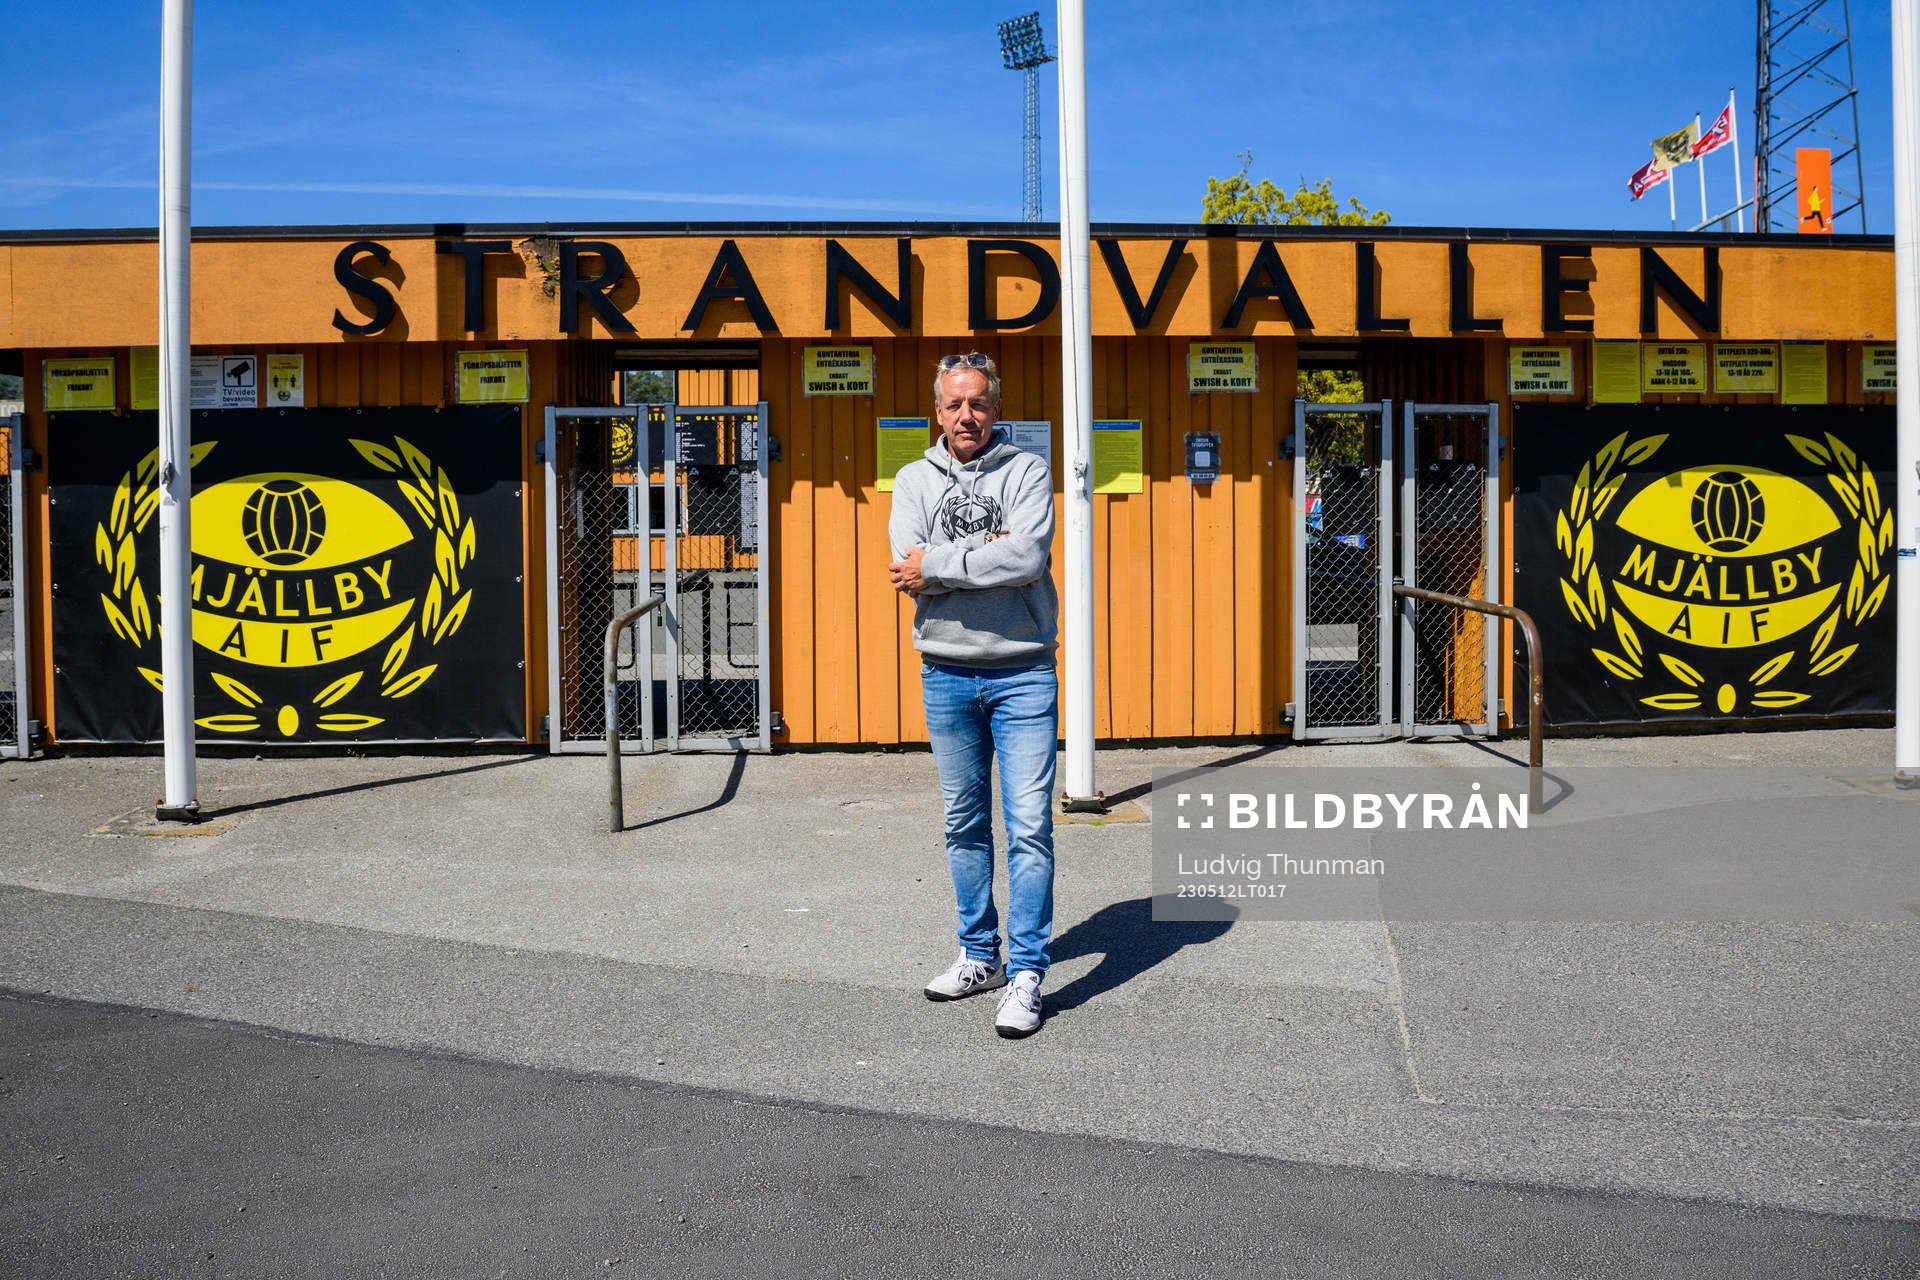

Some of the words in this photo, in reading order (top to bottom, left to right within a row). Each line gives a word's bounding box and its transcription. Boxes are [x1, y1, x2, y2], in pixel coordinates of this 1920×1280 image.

[333, 238, 1722, 334] STRANDVALLEN
[808, 381, 838, 392] SWISH
[839, 382, 845, 391] &
[847, 381, 869, 391] KORT
[1193, 377, 1221, 387] SWISH
[1222, 379, 1229, 387] &
[1230, 377, 1252, 387] KORT
[1514, 381, 1541, 390] SWISH
[1541, 382, 1548, 390] &
[1549, 380, 1569, 390] KORT
[1866, 379, 1893, 388] SWISH
[222, 388, 256, 396] TV/video
[1619, 544, 1823, 601] MJÄLLBY
